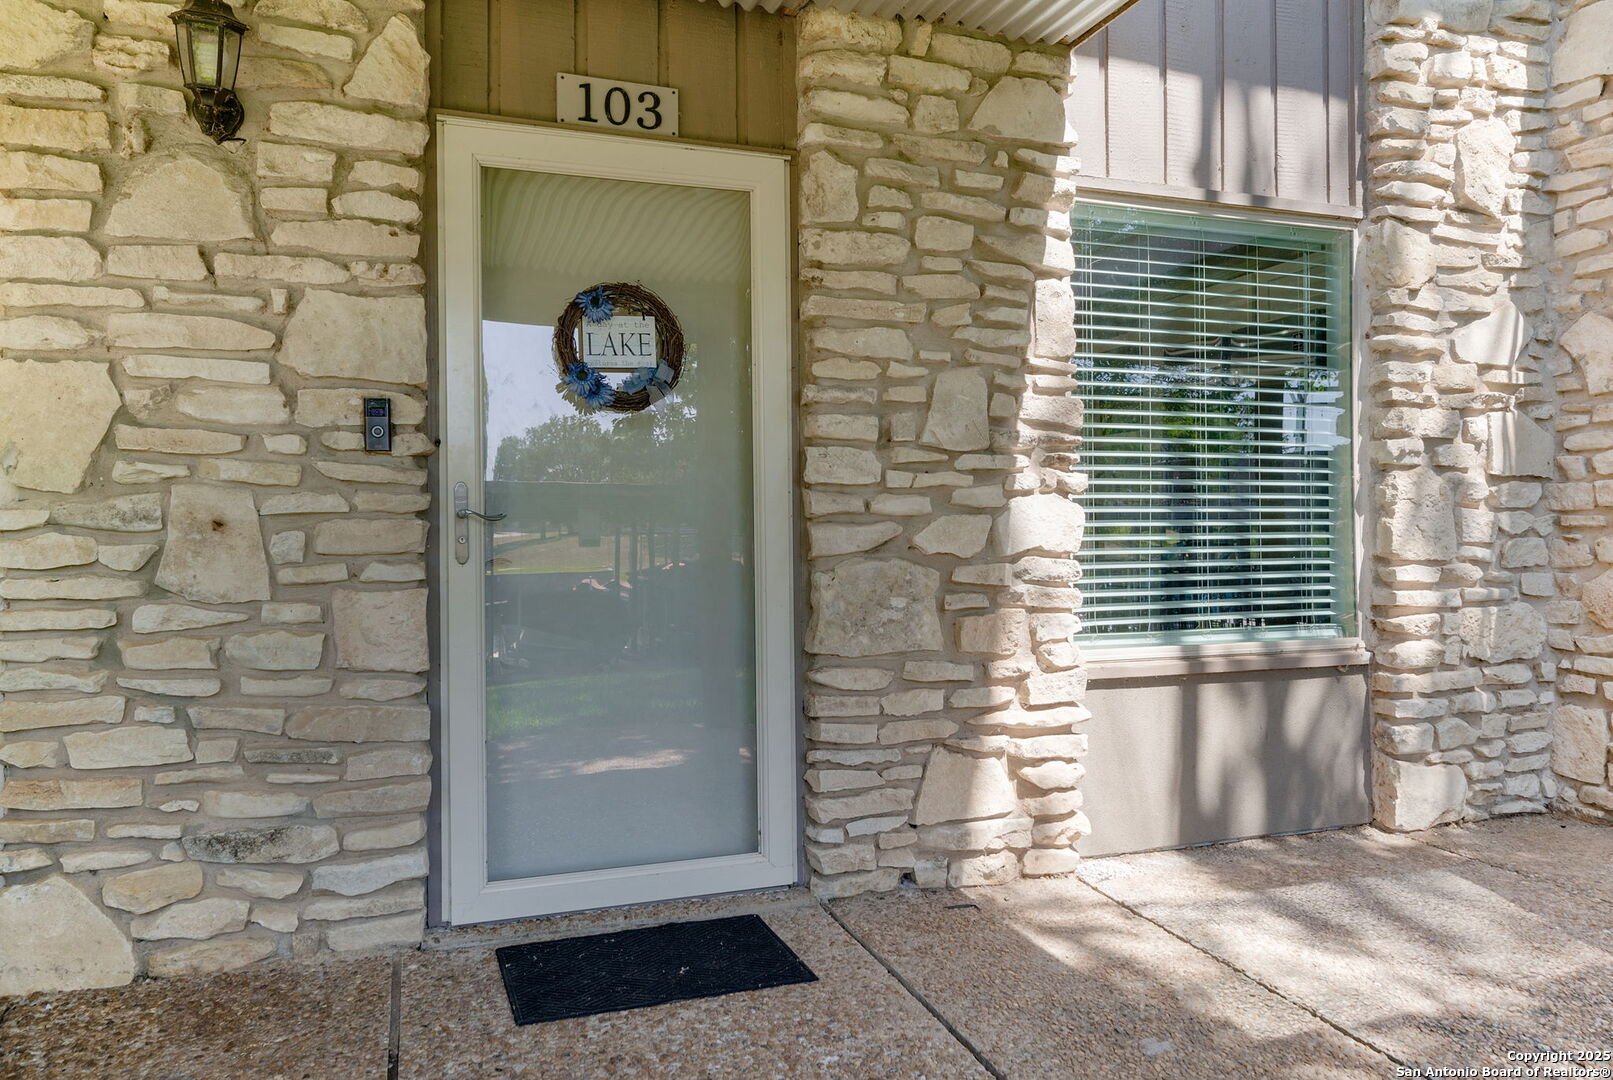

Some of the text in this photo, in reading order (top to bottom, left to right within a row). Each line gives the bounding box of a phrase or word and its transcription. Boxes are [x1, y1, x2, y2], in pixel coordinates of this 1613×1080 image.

[578, 83, 662, 130] 103
[634, 321, 650, 329] the
[586, 332, 652, 357] LAKE
